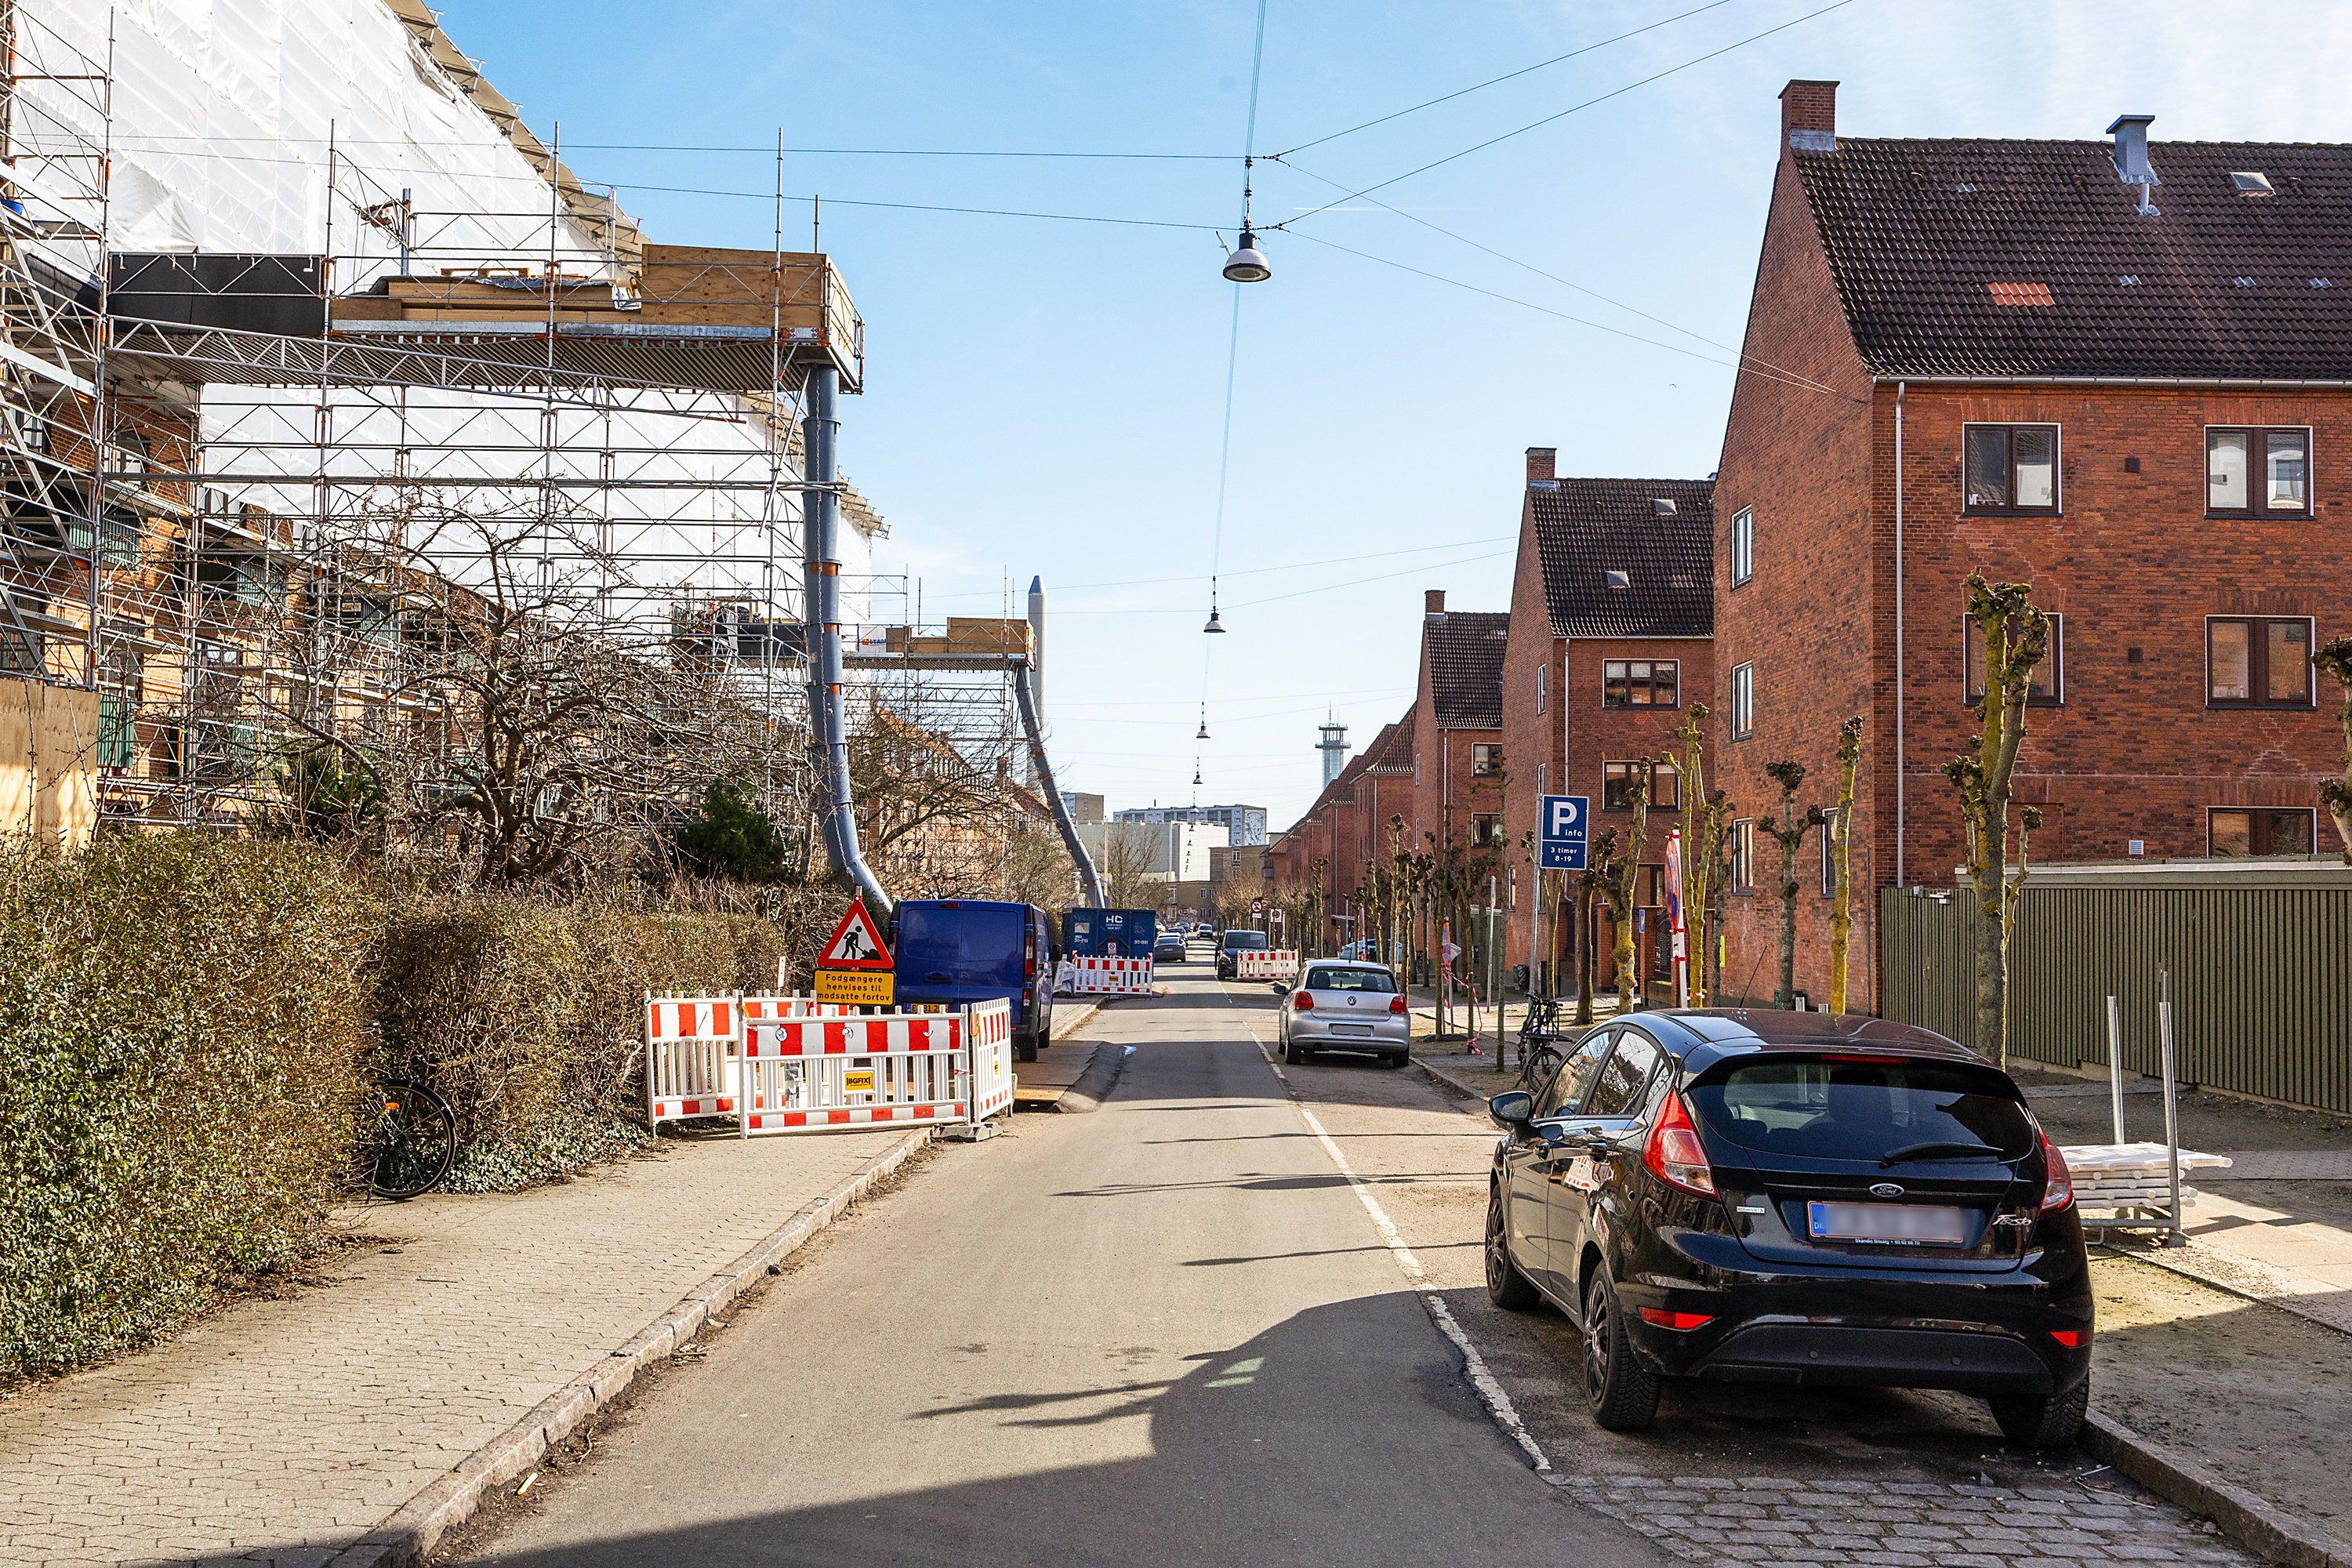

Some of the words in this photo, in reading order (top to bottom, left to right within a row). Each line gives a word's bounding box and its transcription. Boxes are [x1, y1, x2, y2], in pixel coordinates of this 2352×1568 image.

[1552, 801, 1577, 836] P
[826, 974, 883, 983] Fodgængere
[1877, 1186, 1897, 1195] Ford
